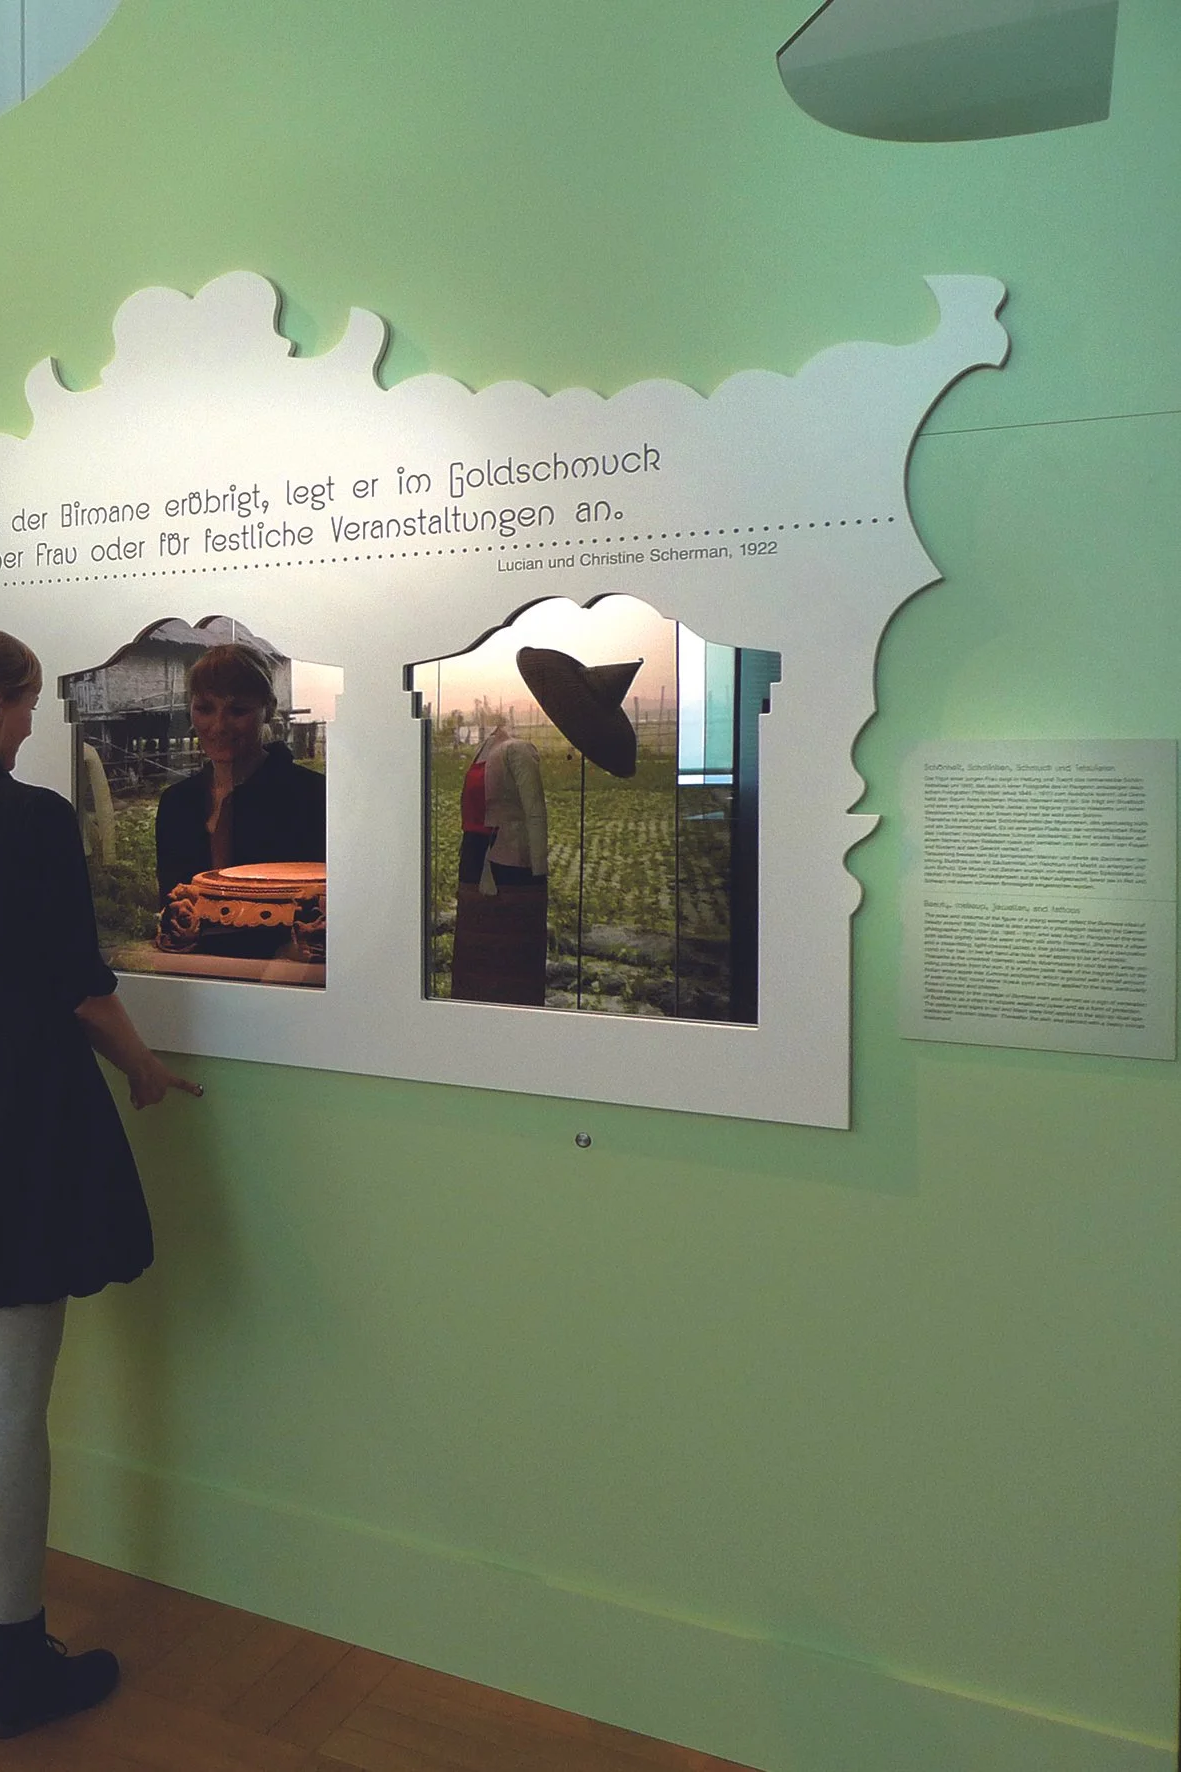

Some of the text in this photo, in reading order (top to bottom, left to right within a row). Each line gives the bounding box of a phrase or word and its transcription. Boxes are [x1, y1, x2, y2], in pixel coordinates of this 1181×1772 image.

[12, 508, 48, 533] der
[61, 501, 150, 528] Birmane
[287, 476, 335, 510] legt
[353, 478, 379, 498] er
[397, 466, 431, 495] im
[450, 443, 661, 498] Goldschmuck
[36, 543, 77, 567] Frau
[91, 536, 145, 562] oder
[160, 532, 190, 557] für
[205, 521, 313, 553] festliche
[331, 507, 555, 542] Veranstaltungen
[575, 500, 624, 522] an.
[498, 541, 778, 573] Lucian und Christine Scherman, 1922
